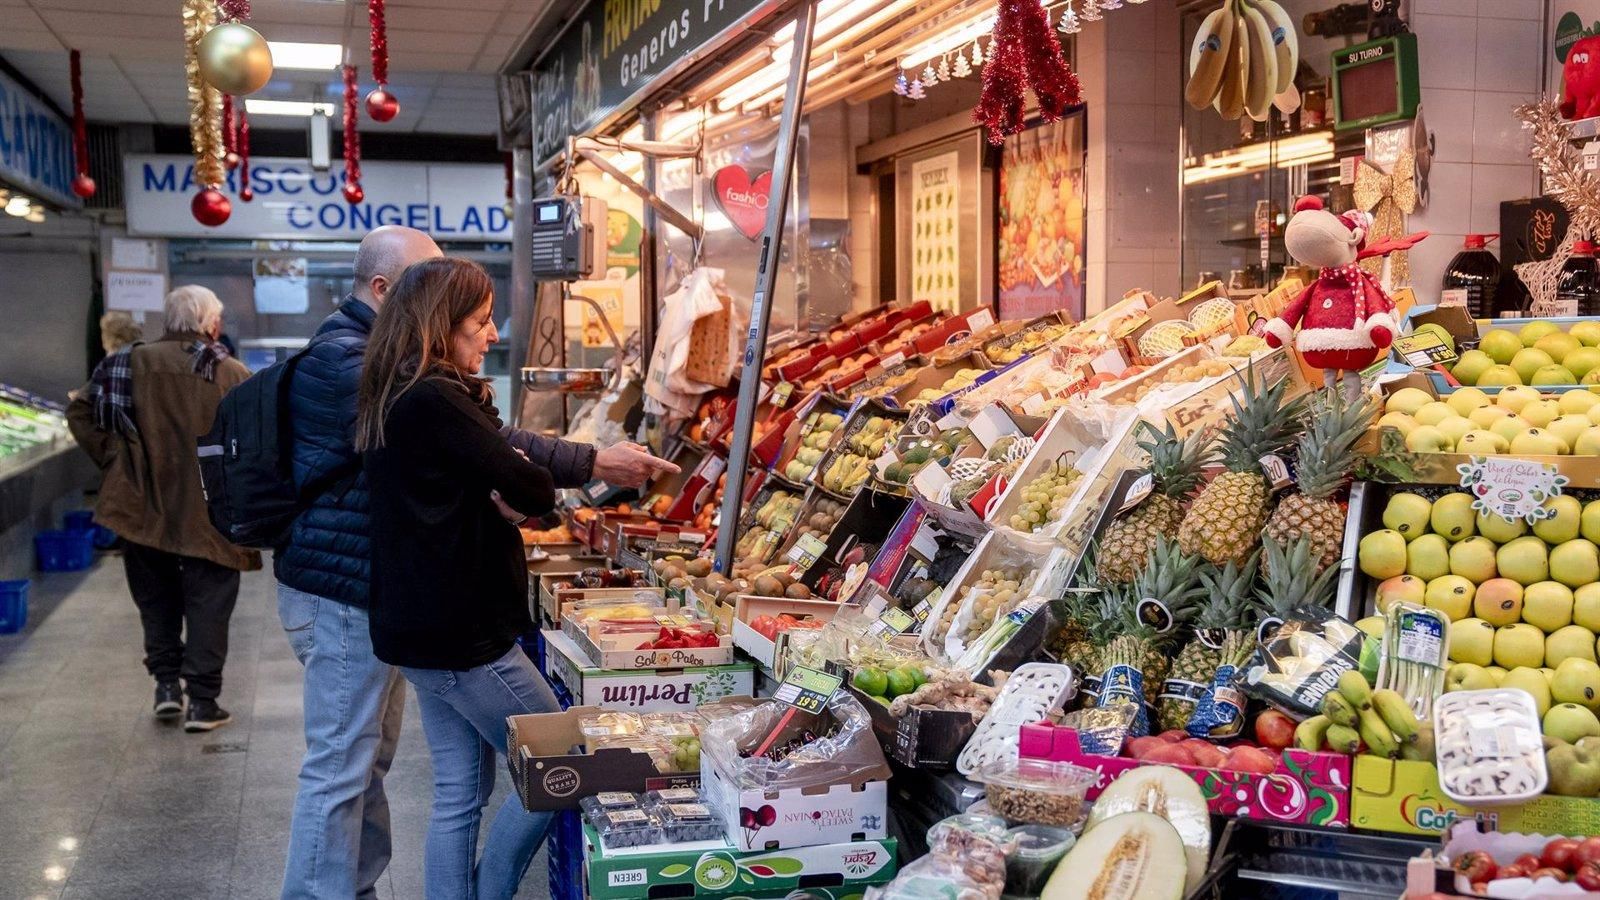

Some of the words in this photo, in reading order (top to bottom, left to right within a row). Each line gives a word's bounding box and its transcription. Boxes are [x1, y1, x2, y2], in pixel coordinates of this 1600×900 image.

[620, 8, 690, 87] Generos
[1348, 52, 1358, 63] SU
[1359, 46, 1383, 60] TURNO
[634, 650, 657, 668] Sol
[672, 650, 704, 666] Palos
[601, 683, 692, 707] Perlim
[547, 773, 572, 784] QUALITY
[550, 779, 576, 790] BRAND
[842, 851, 877, 865] Zespri
[613, 872, 643, 883] GREEN
